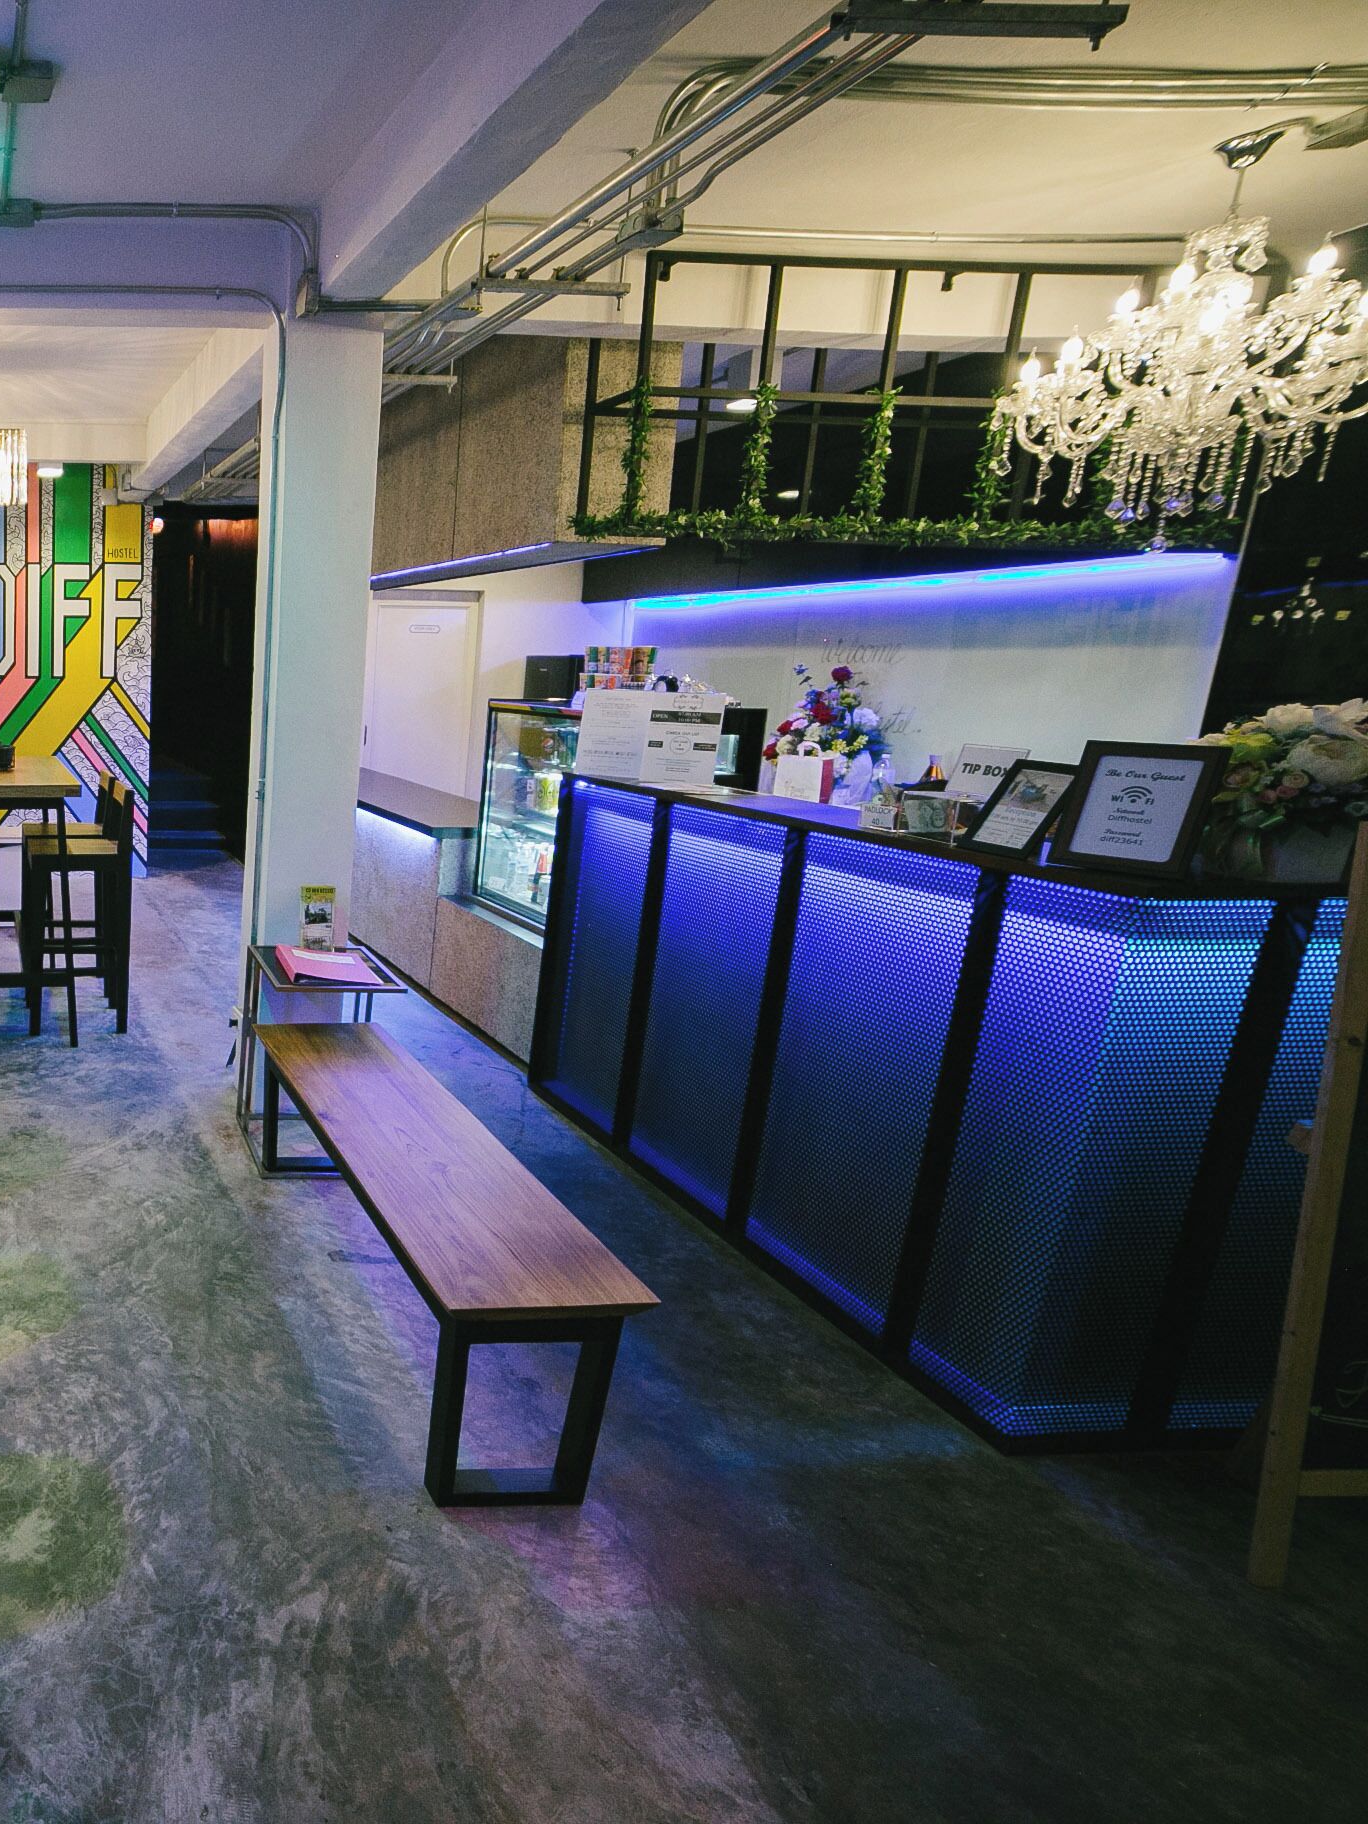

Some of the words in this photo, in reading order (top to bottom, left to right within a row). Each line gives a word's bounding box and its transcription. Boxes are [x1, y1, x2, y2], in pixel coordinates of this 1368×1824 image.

[107, 547, 139, 560] HOSTEL
[961, 762, 982, 775] TIP
[982, 764, 1008, 778] BOX
[1105, 768, 1121, 778] Be
[1125, 769, 1147, 779] Our
[1150, 771, 1186, 781] Guest
[1111, 794, 1124, 803] WI
[1144, 798, 1155, 806] FI
[1107, 814, 1153, 825] Diffhostel
